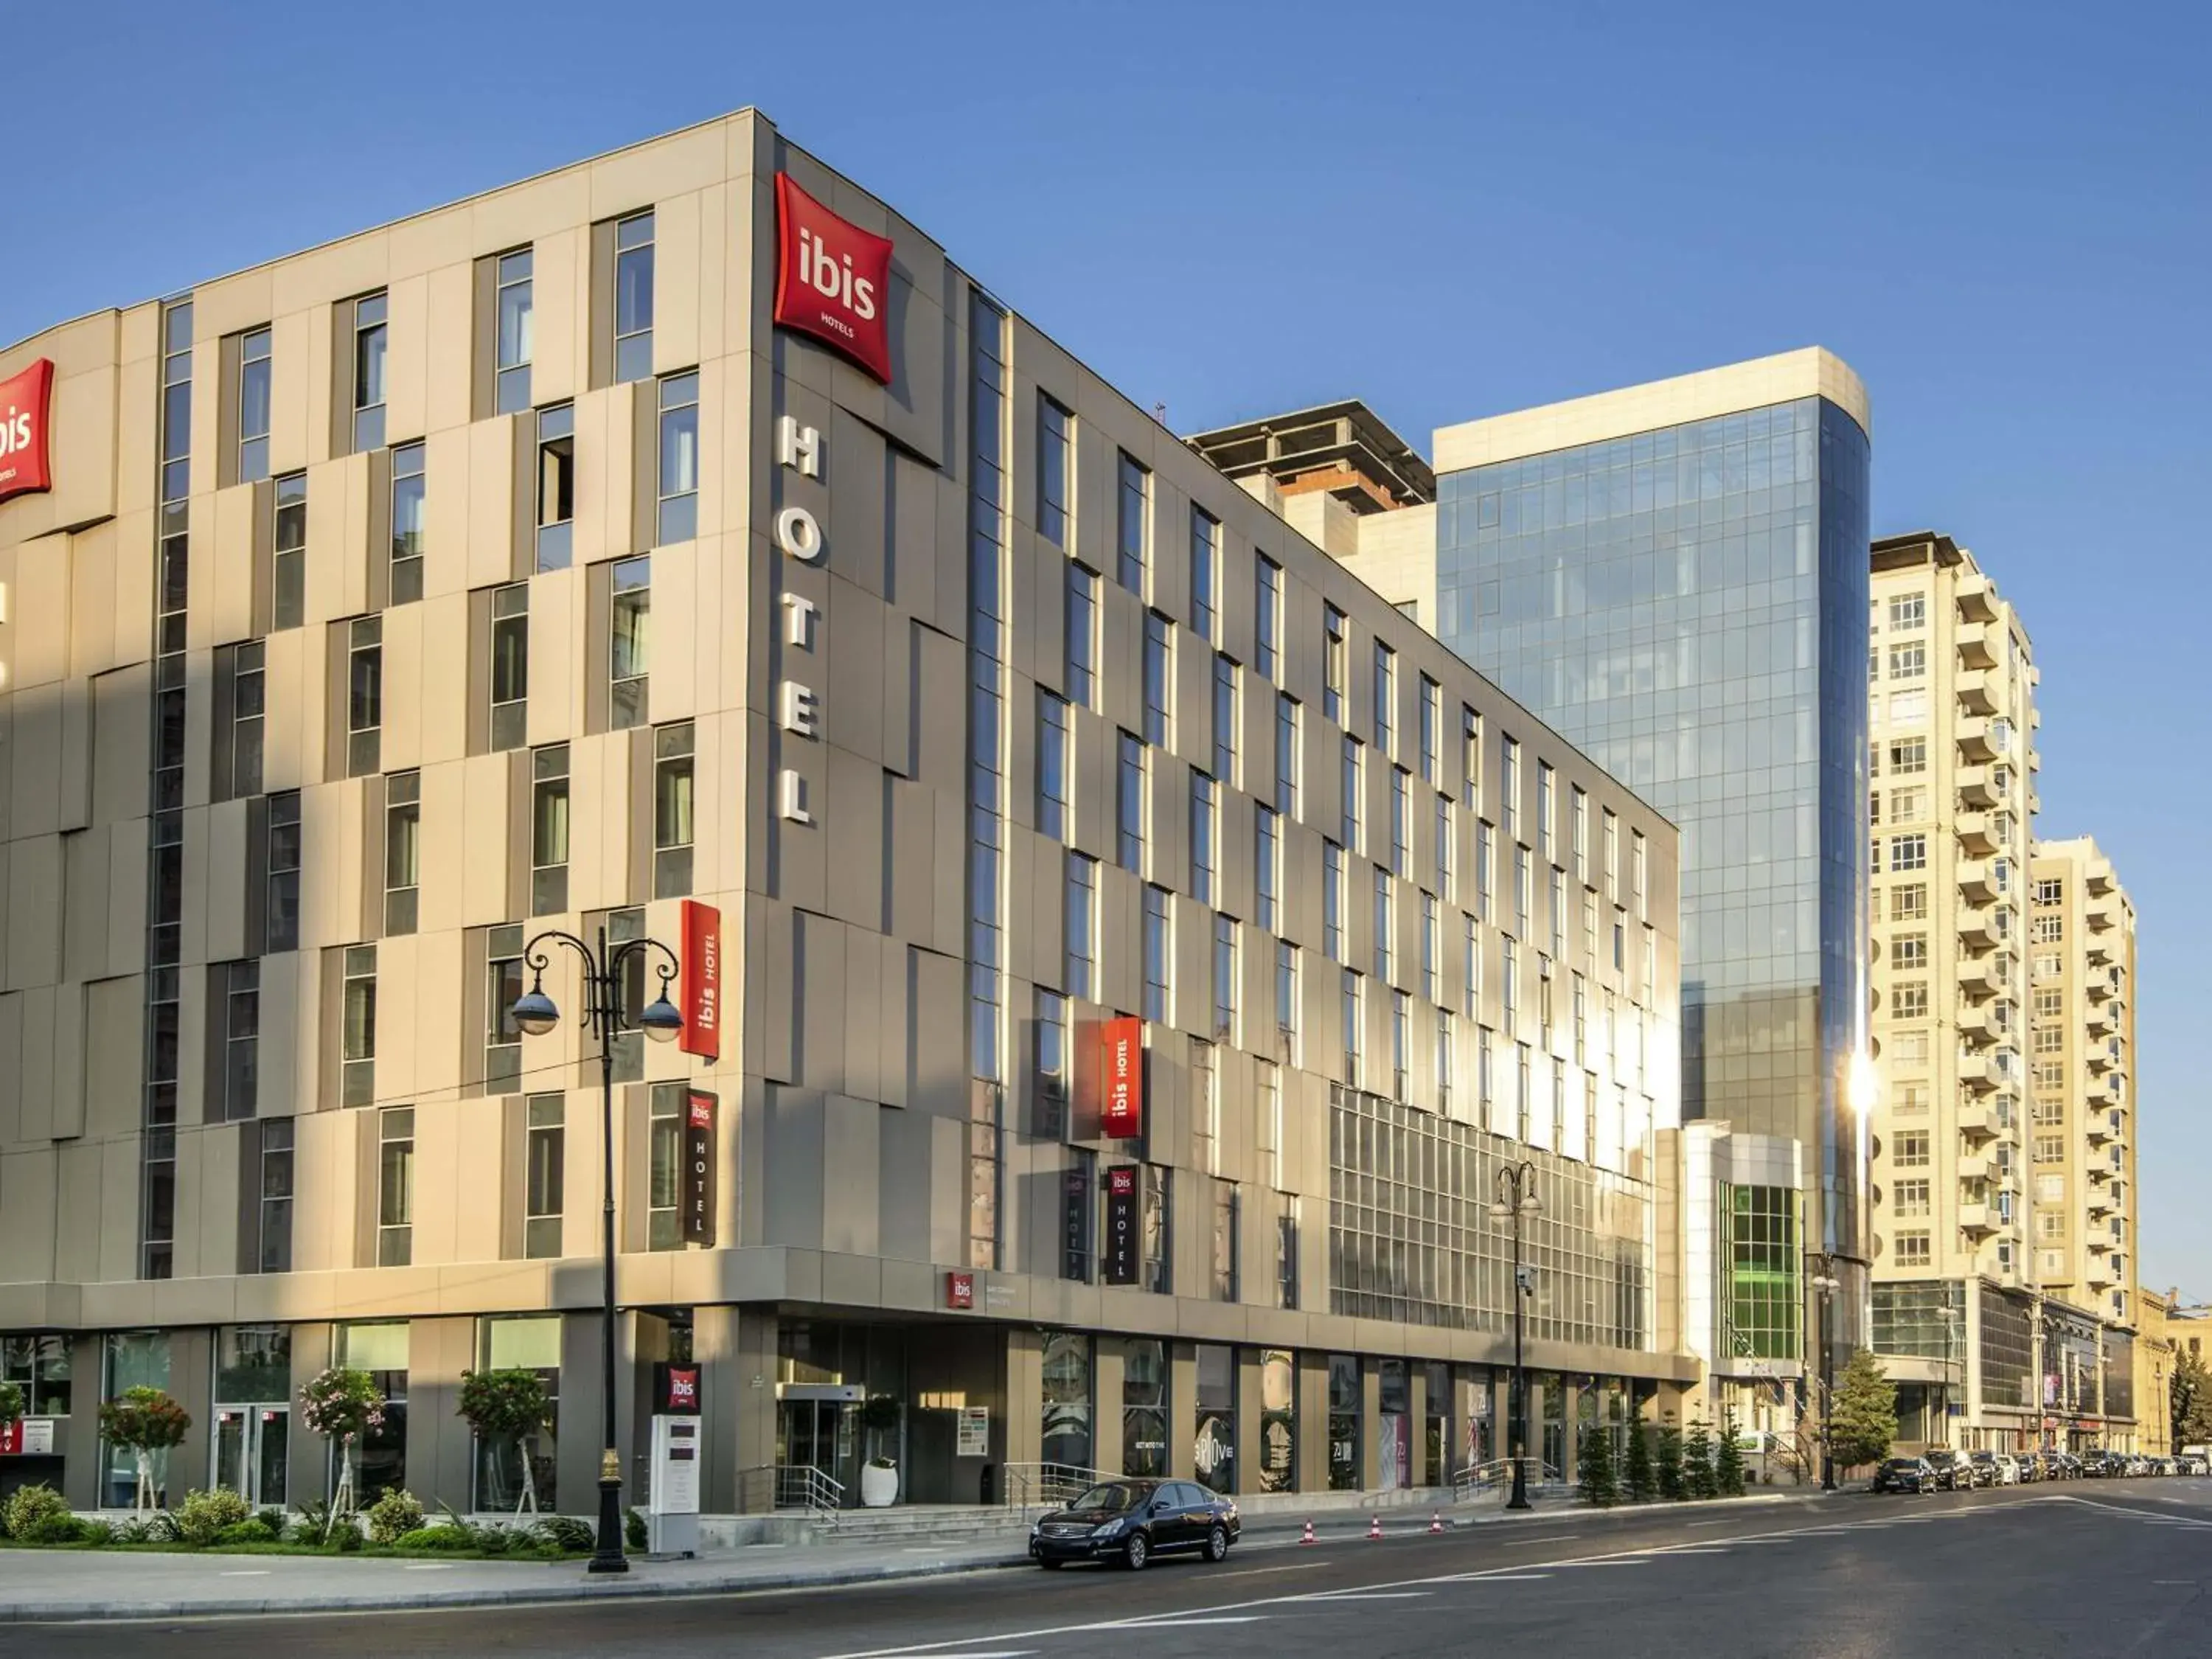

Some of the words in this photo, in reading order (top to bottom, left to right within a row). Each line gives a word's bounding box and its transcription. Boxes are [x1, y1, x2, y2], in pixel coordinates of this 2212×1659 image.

[800, 227, 875, 320] ibis
[821, 312, 854, 338] HOTELS
[0, 405, 31, 457] is
[778, 415, 821, 824] HOTEL
[698, 987, 714, 1029] ibis
[706, 933, 715, 980] HOTEL
[1117, 1038, 1127, 1077] HOTEL
[692, 1105, 709, 1120] ibis
[1112, 1083, 1127, 1116] ibis
[695, 1142, 706, 1231] HOTEL
[1114, 1176, 1130, 1188] ibis
[1117, 1206, 1126, 1276] HOTEL
[955, 1281, 970, 1296] ibis
[673, 1379, 693, 1395] ibis
